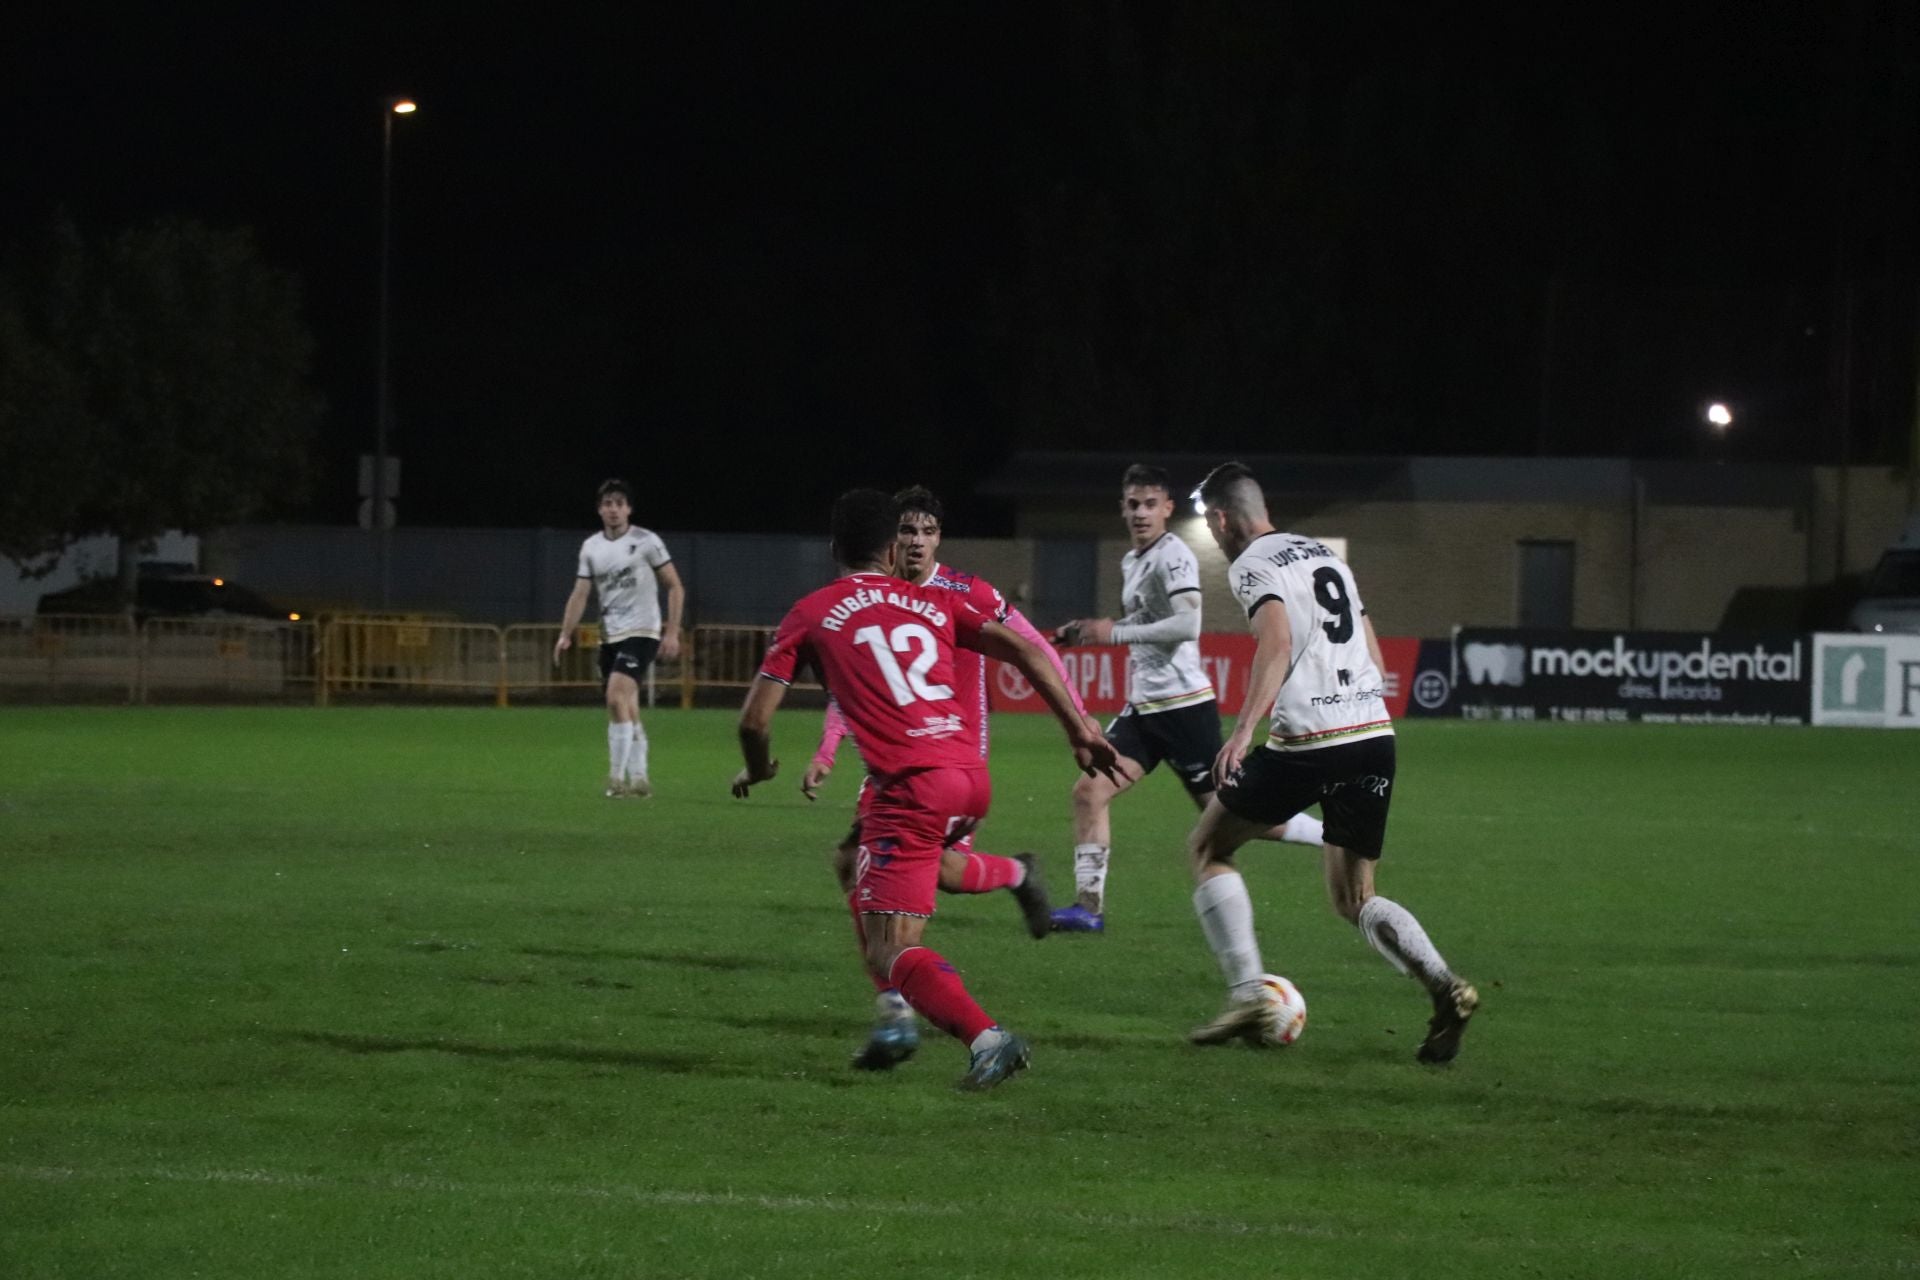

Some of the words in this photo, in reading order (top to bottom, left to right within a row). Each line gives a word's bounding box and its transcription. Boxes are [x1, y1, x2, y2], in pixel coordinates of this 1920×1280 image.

[1267, 547, 1300, 568] LUIS
[821, 588, 886, 632] RUBÉN
[887, 592, 948, 627] ALVES
[1312, 566, 1354, 644] 9
[853, 623, 955, 707] 12
[1060, 653, 1116, 700] OPA
[1531, 635, 1801, 699] mockupdental
